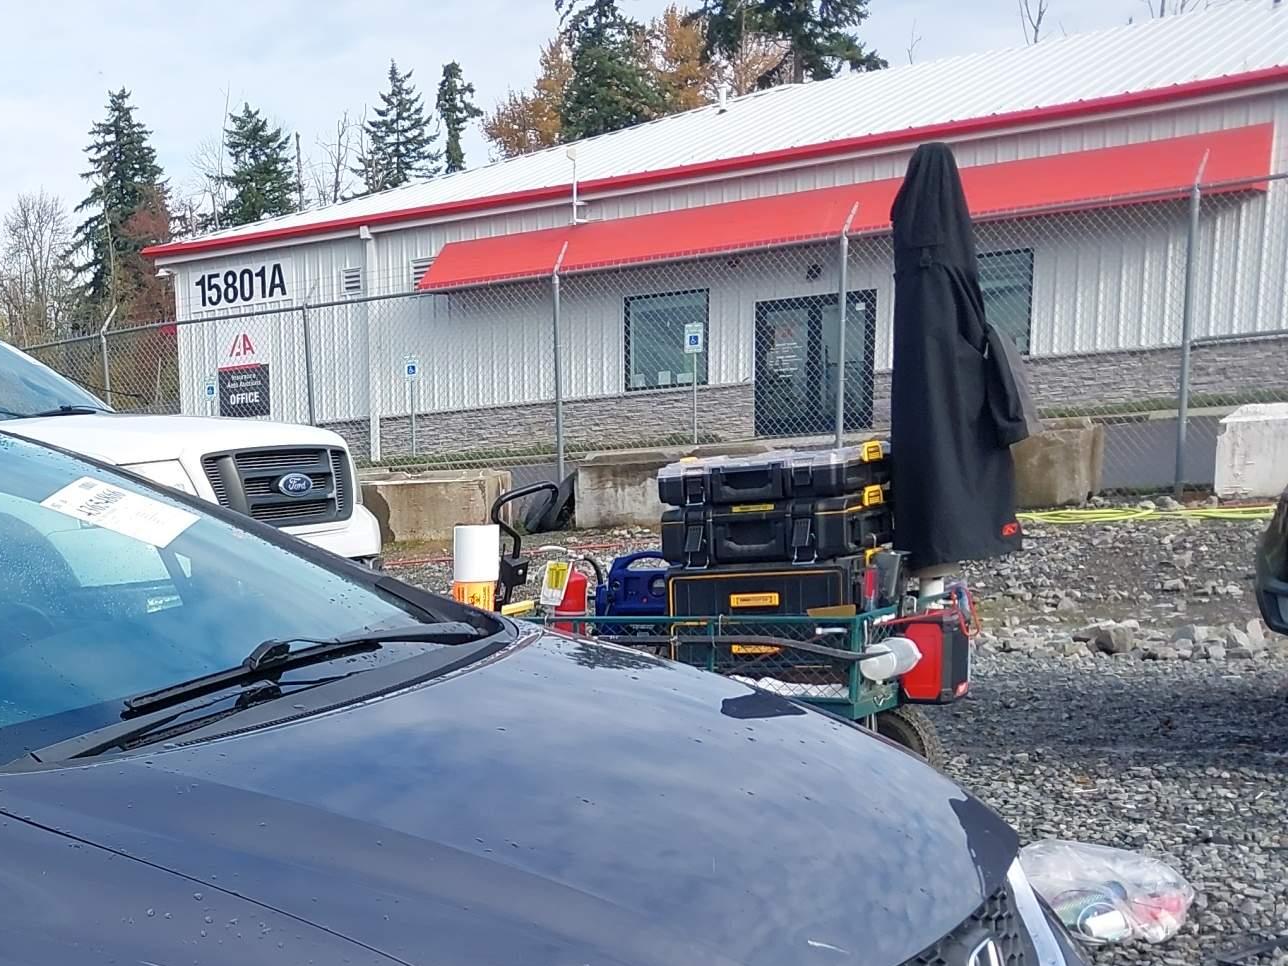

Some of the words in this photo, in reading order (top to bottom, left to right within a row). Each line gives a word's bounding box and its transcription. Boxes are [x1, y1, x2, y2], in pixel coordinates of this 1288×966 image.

[195, 263, 287, 307] 15801A
[229, 391, 260, 405] OFFICE
[288, 477, 307, 490] Ford
